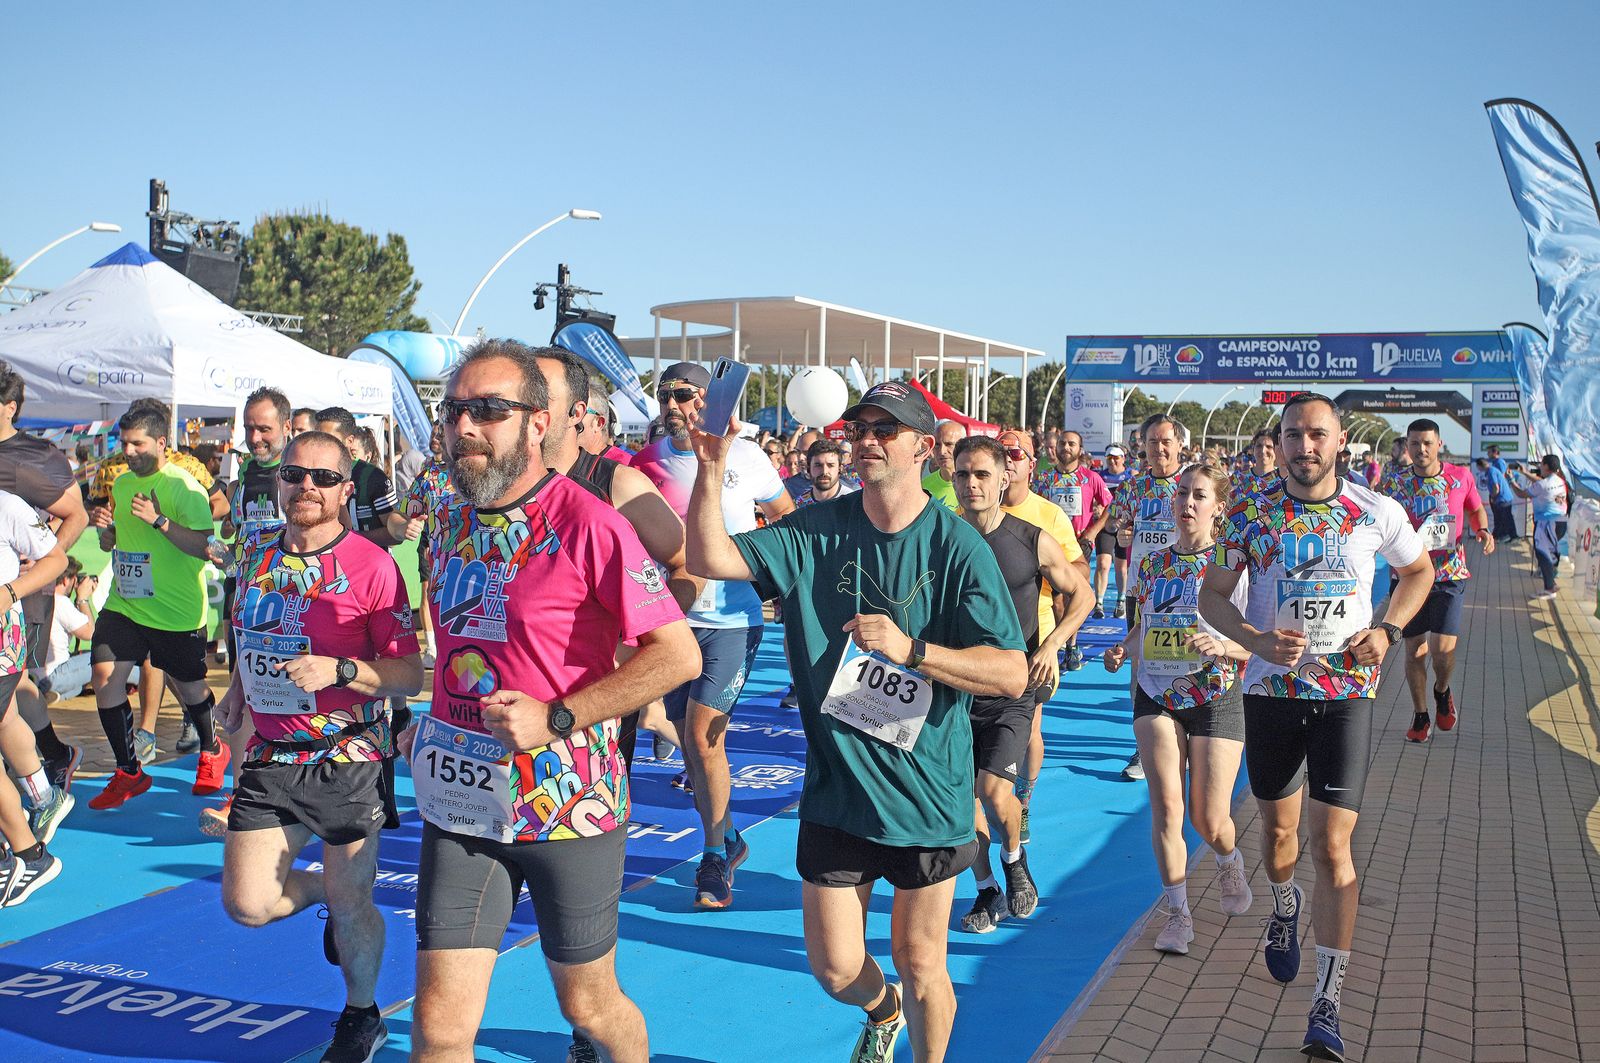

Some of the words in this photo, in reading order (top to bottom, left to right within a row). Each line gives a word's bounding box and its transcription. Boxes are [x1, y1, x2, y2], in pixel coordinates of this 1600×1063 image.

[1218, 340, 1321, 352] CAMPEONATO
[1217, 356, 1233, 367] de
[1237, 354, 1287, 367] ESPAÑA
[1297, 353, 1320, 369] 10
[1326, 352, 1357, 369] km
[1399, 348, 1442, 362] HUELVA
[1480, 350, 1513, 363] WiH
[1178, 365, 1199, 373] WiHu
[1284, 369, 1319, 377] Absoluto
[1328, 369, 1357, 377] Master
[1057, 495, 1074, 503] 715
[1139, 532, 1168, 545] 1856
[120, 563, 143, 577] 875
[1330, 584, 1352, 594] 2023
[1290, 600, 1346, 620] 1574
[1174, 617, 1193, 626] 2023
[856, 659, 918, 704] 1083
[261, 698, 284, 708] Syrluz
[448, 701, 484, 724] WiH
[859, 713, 884, 730] Syrluz
[472, 740, 502, 759] 2023
[426, 750, 494, 792] 1552
[444, 789, 470, 800] PEDRO
[464, 803, 488, 813] JOVER
[447, 812, 476, 826] Syrluz
[41, 960, 149, 981] original
[0, 971, 310, 1041] Huelva
